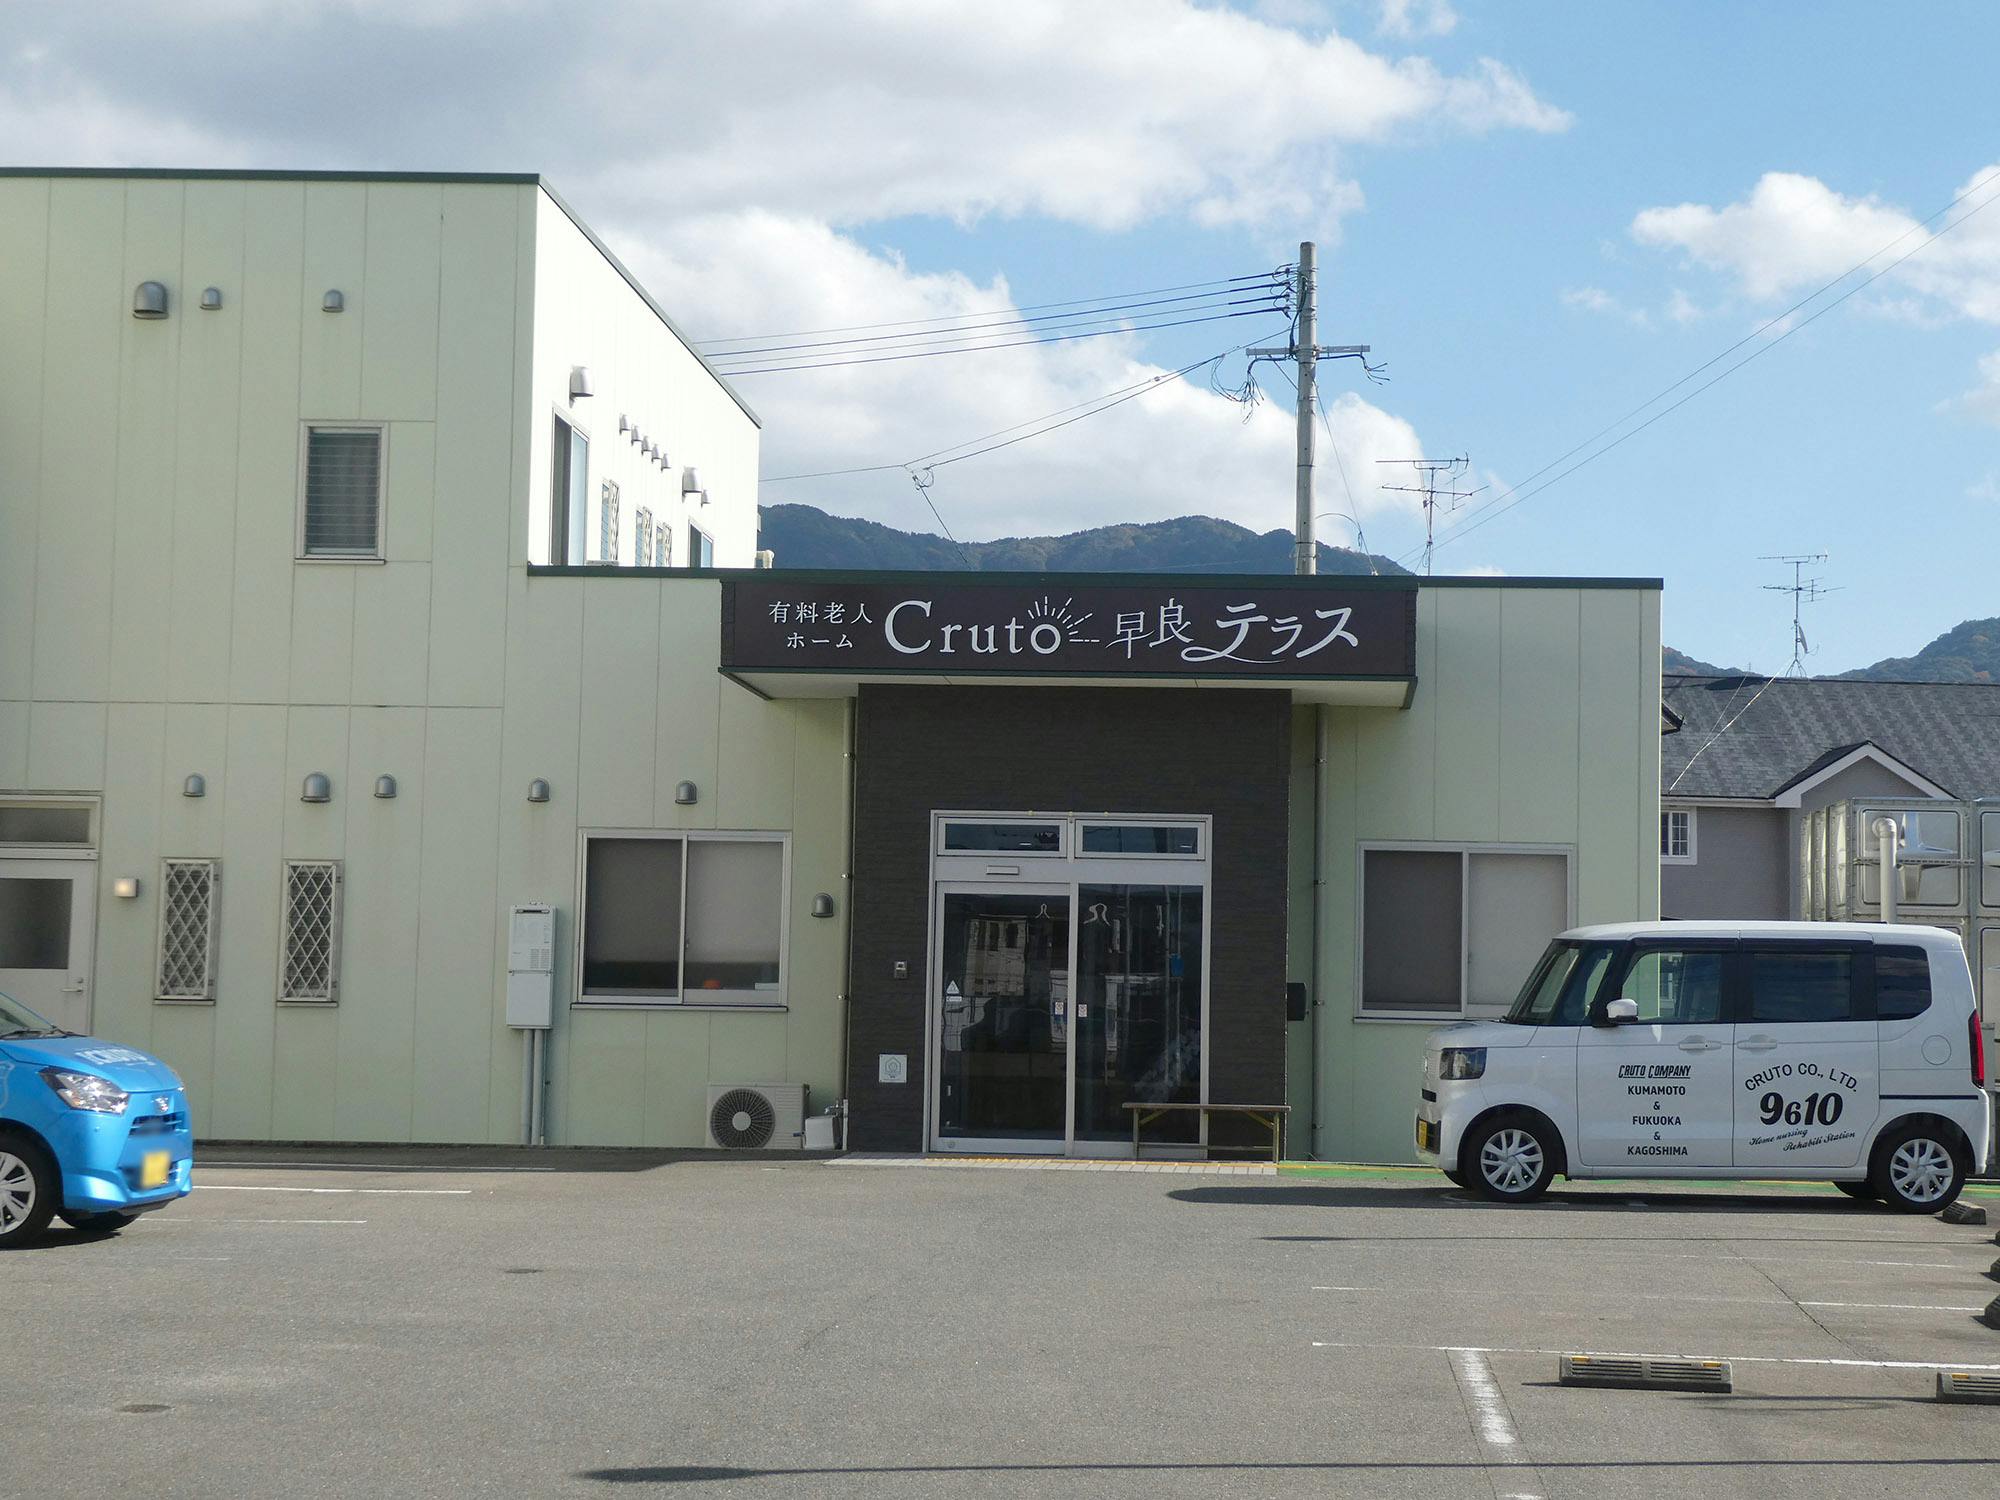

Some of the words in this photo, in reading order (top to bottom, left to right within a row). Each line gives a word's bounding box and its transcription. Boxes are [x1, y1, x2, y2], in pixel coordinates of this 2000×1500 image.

[769, 601, 873, 624] 有料老人
[885, 600, 1062, 654] Cruto
[787, 632, 853, 649] ホーム
[1618, 1065, 1646, 1078] CRUTO
[1648, 1065, 1691, 1079] COMPANY
[1745, 1064, 1792, 1091] CRUTO
[1798, 1063, 1824, 1078] CO.,
[1829, 1068, 1857, 1092] LTD.
[1627, 1086, 1686, 1095] KUMAMOTO
[1653, 1101, 1660, 1110] &
[1760, 1092, 1843, 1126] 9610
[1632, 1116, 1681, 1125] FUKUOKA
[1653, 1131, 1661, 1140] &
[1776, 1128, 1808, 1139] nursing
[1823, 1131, 1855, 1143] Station
[1627, 1146, 1688, 1155] KAGOSHIMA
